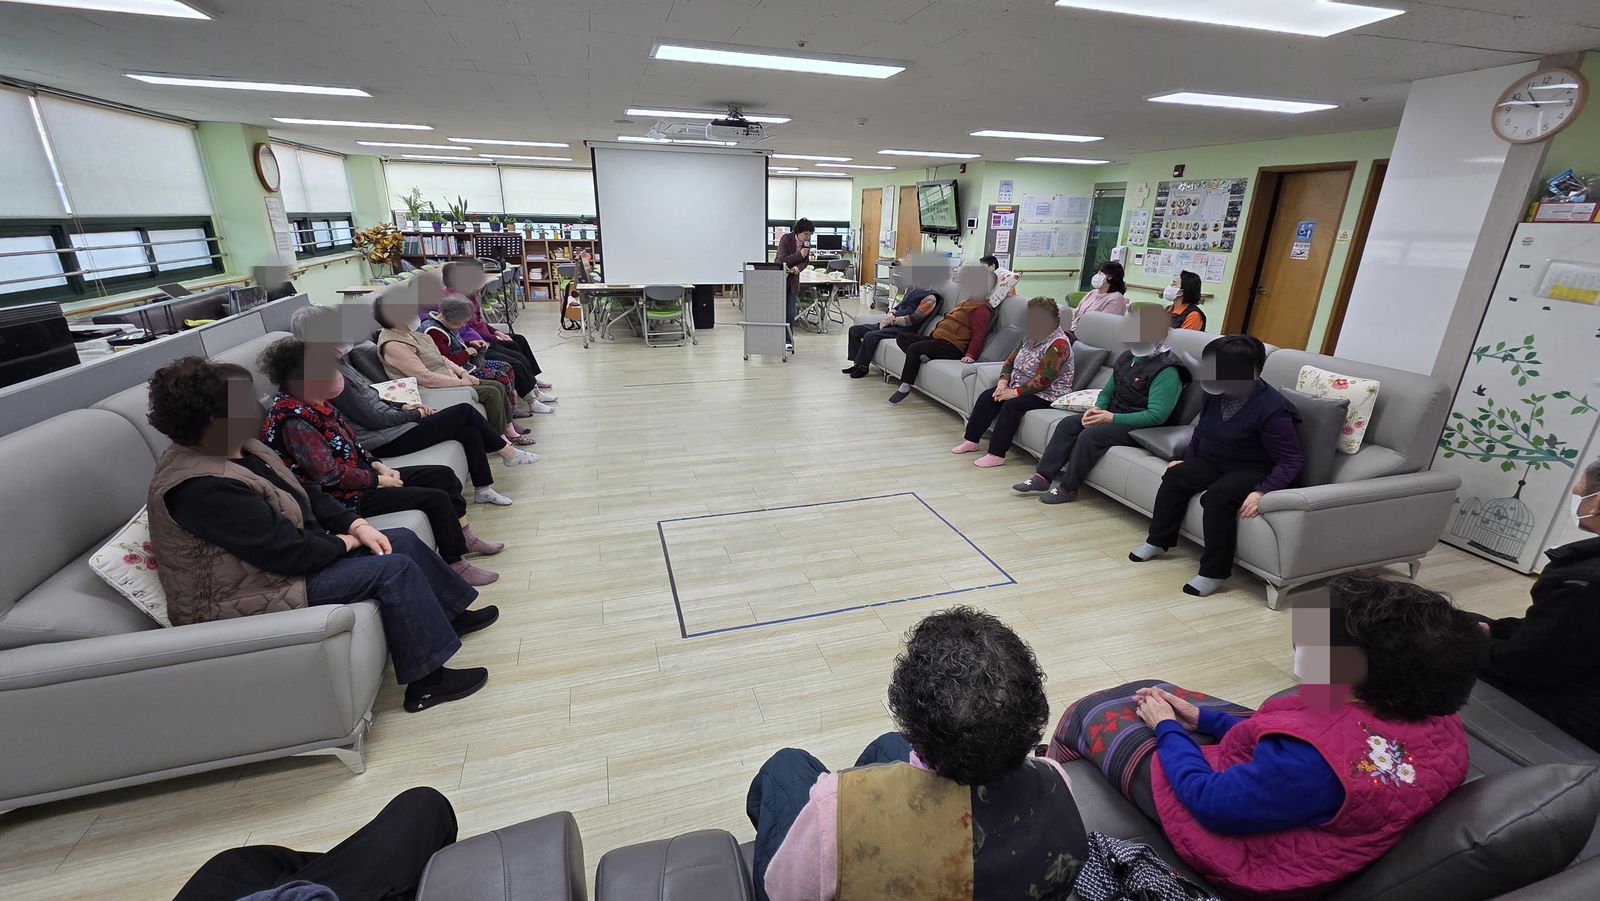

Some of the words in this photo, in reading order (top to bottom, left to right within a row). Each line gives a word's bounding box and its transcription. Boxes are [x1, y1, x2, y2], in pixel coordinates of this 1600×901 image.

[1543, 76, 1552, 84] 12
[1566, 99, 1573, 107] 3
[1557, 112, 1564, 120] 4
[1504, 118, 1511, 126] 8
[1542, 123, 1549, 131] 5
